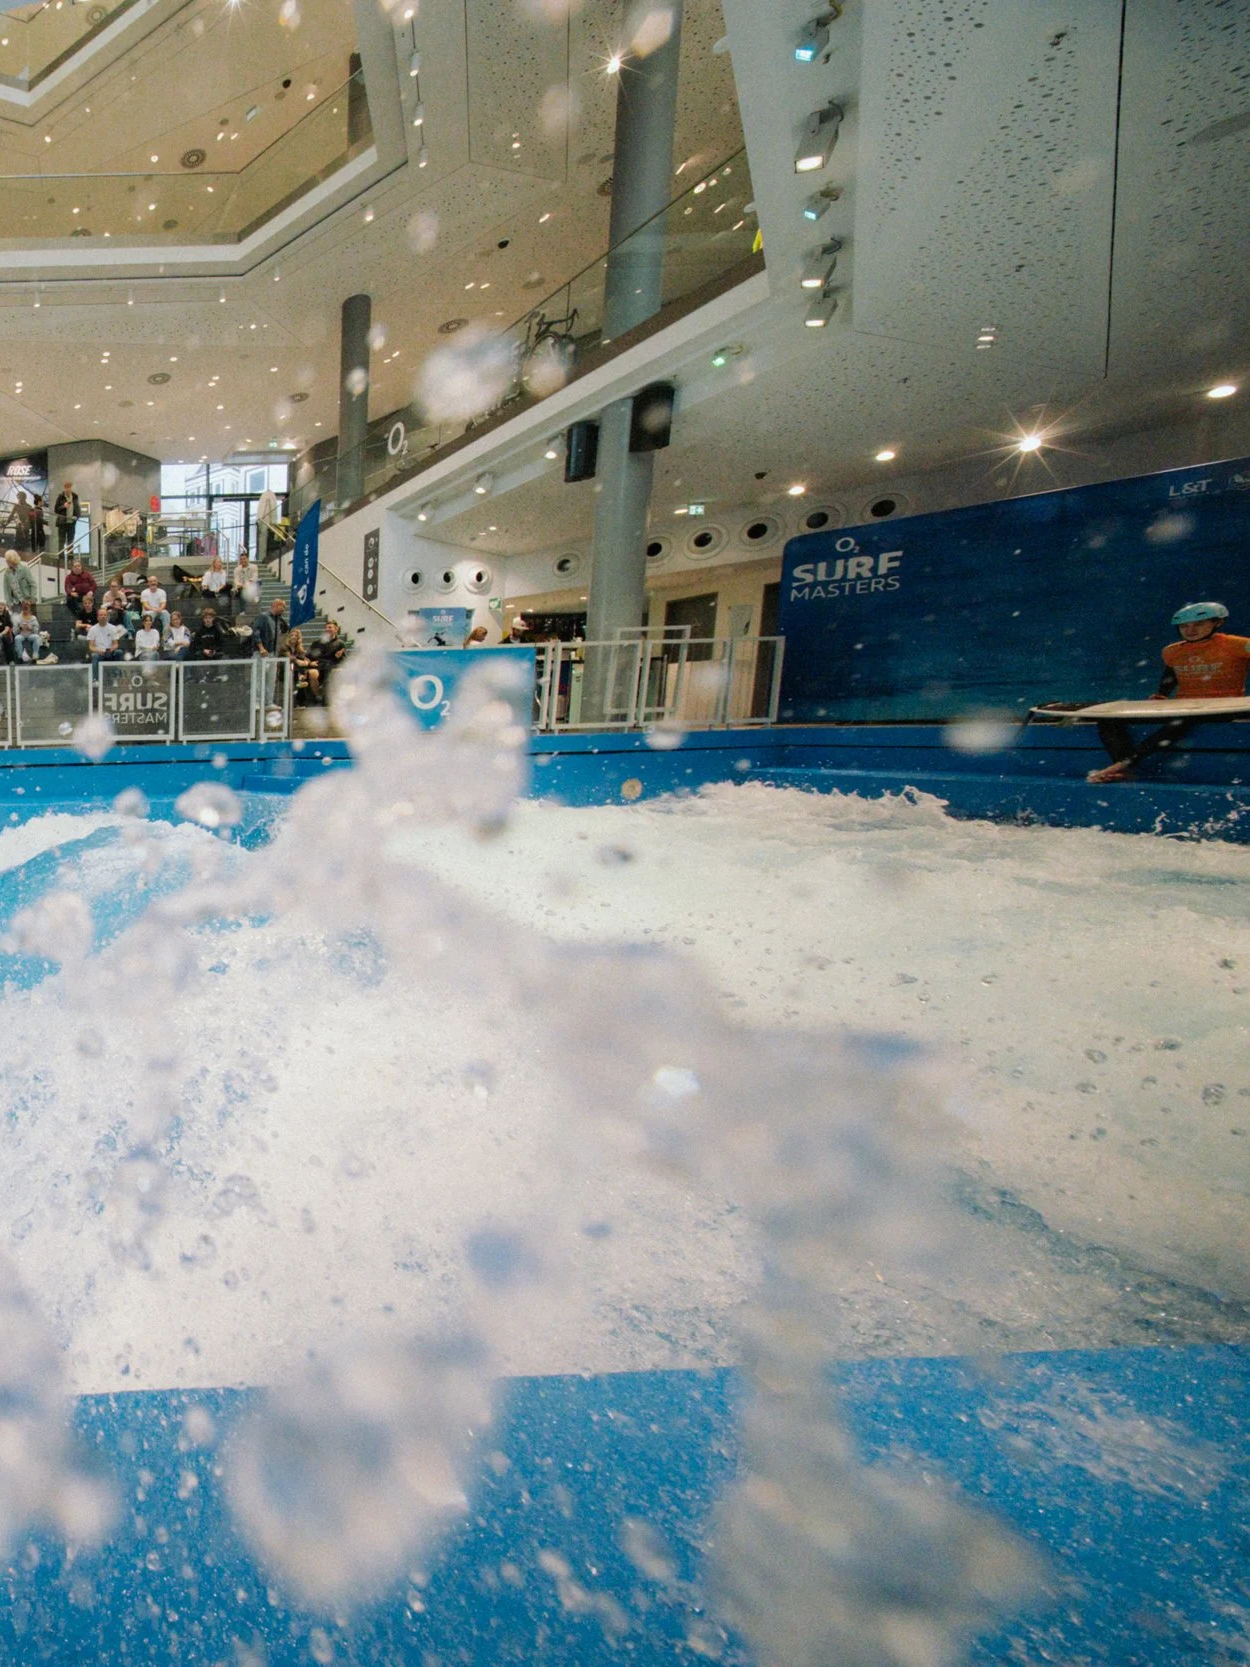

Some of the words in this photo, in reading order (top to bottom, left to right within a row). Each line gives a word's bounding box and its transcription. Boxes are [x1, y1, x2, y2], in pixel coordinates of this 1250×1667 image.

[6, 464, 33, 476] ROSE
[835, 537, 860, 553] O2
[792, 551, 904, 587] SURF
[790, 575, 901, 602] MASTERS
[410, 674, 451, 717] O2
